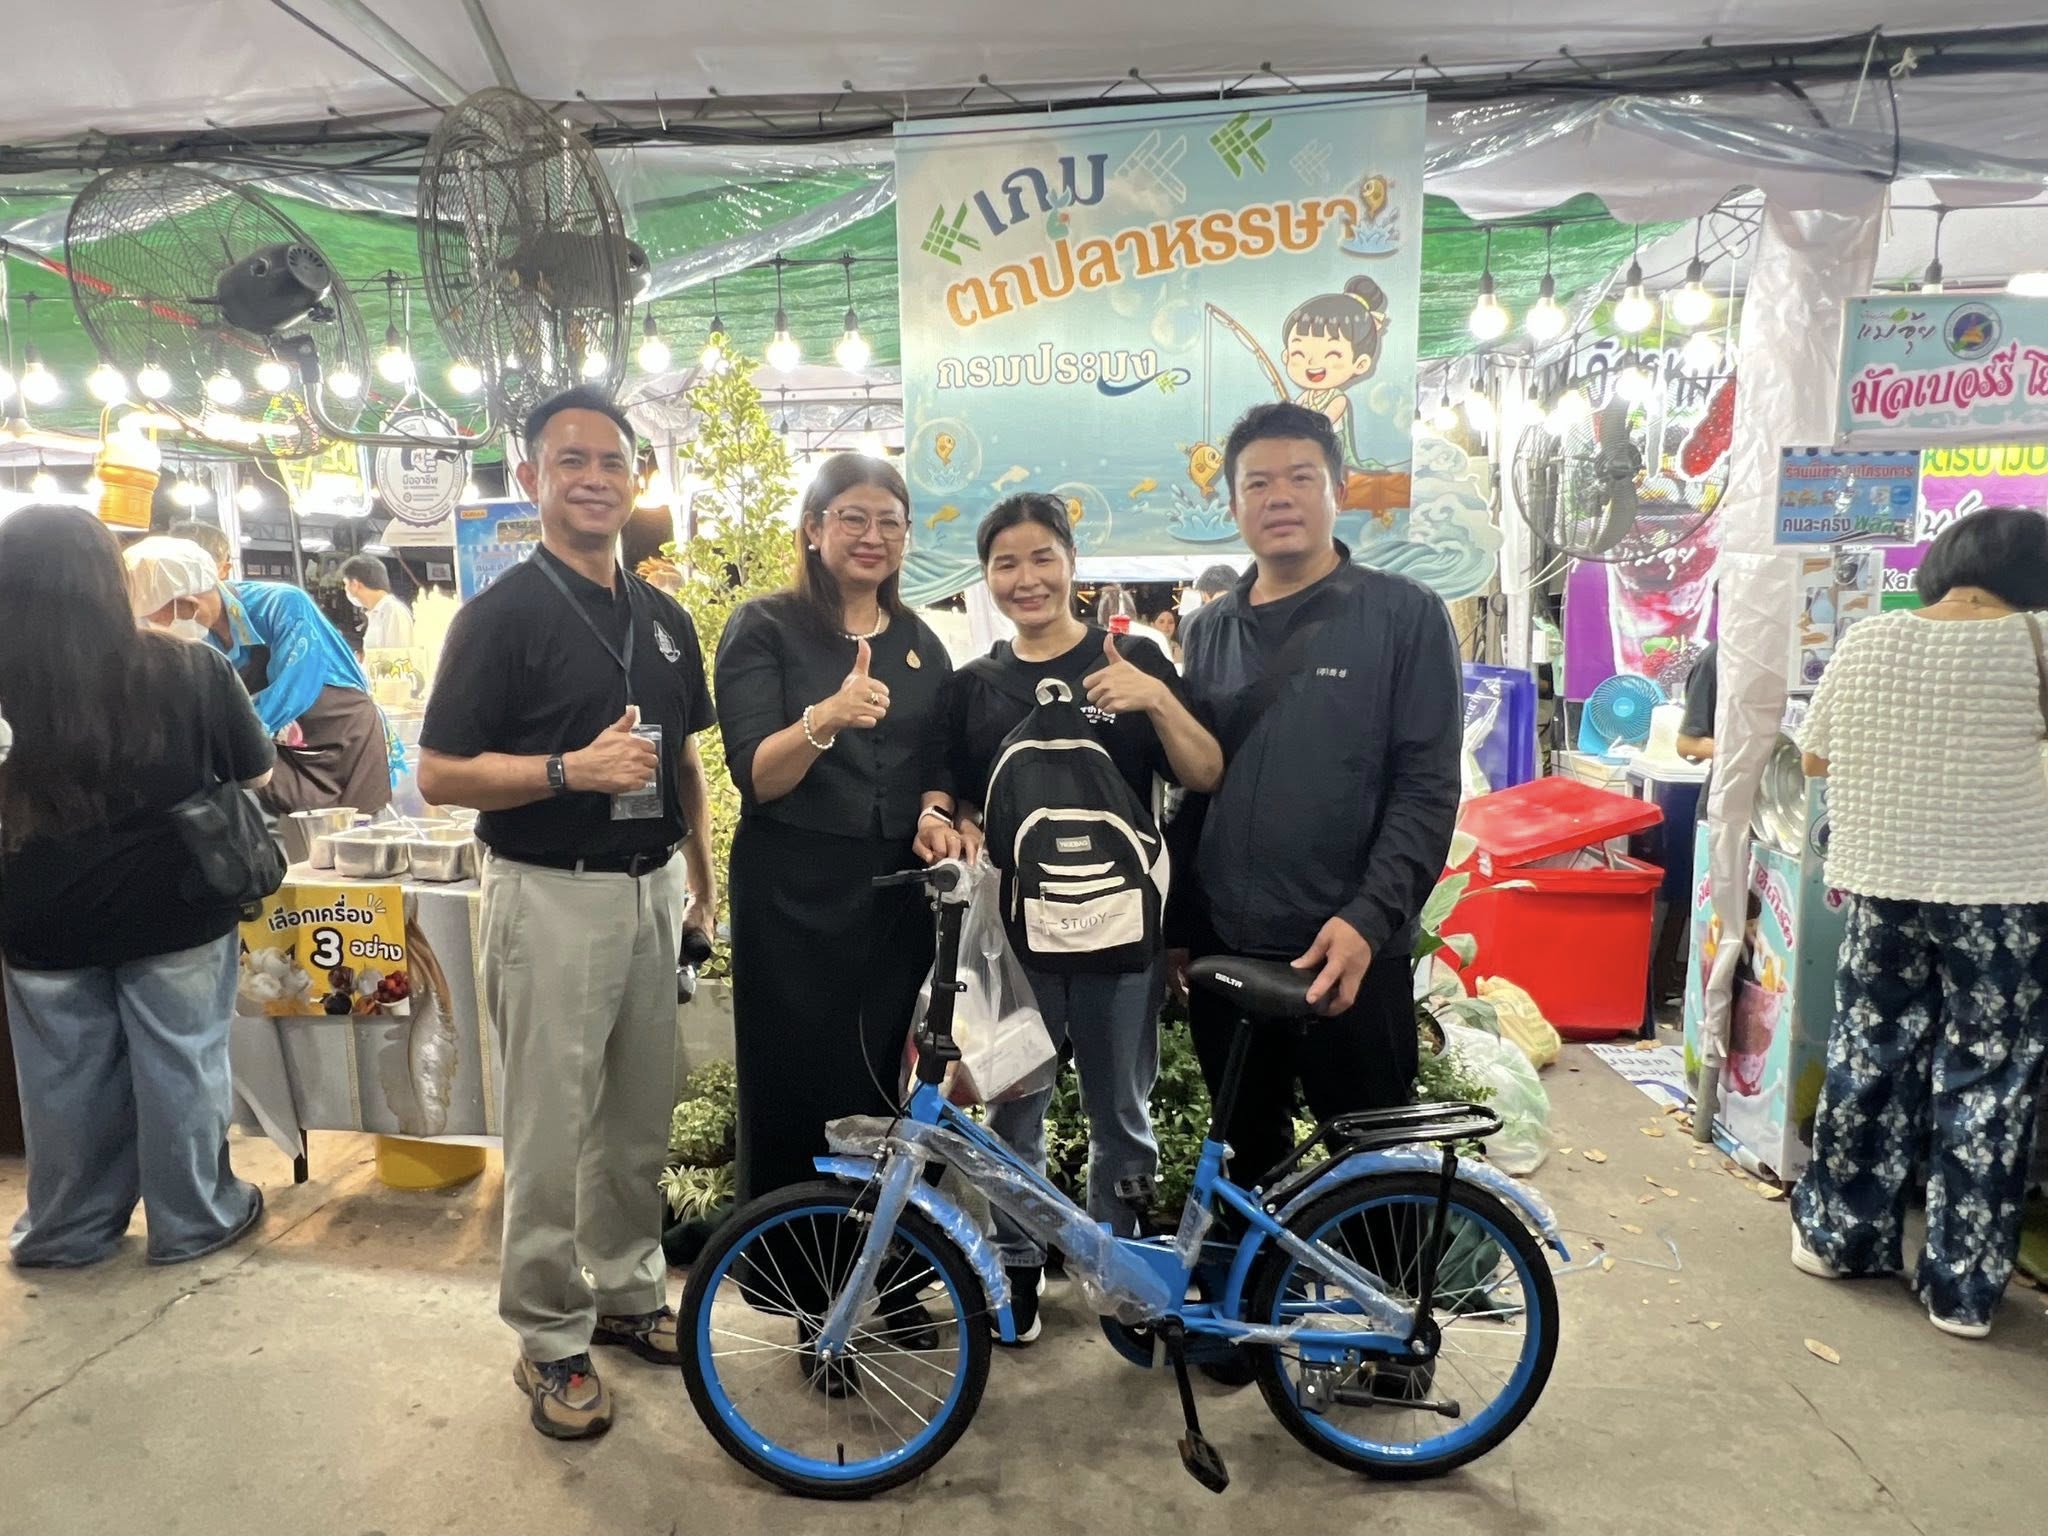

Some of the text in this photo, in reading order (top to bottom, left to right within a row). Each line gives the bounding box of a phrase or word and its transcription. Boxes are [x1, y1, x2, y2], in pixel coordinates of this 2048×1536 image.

[972, 153, 1108, 237] เกม
[946, 198, 1360, 328] ตกปลาหรรษา
[936, 342, 1159, 392] กรมประมง
[1851, 341, 2018, 420] มัลเบอร์รี่
[268, 894, 374, 932] เลือกเครื่อง
[1060, 912, 1109, 931] STUDY
[311, 928, 403, 969] 3 อย่าง
